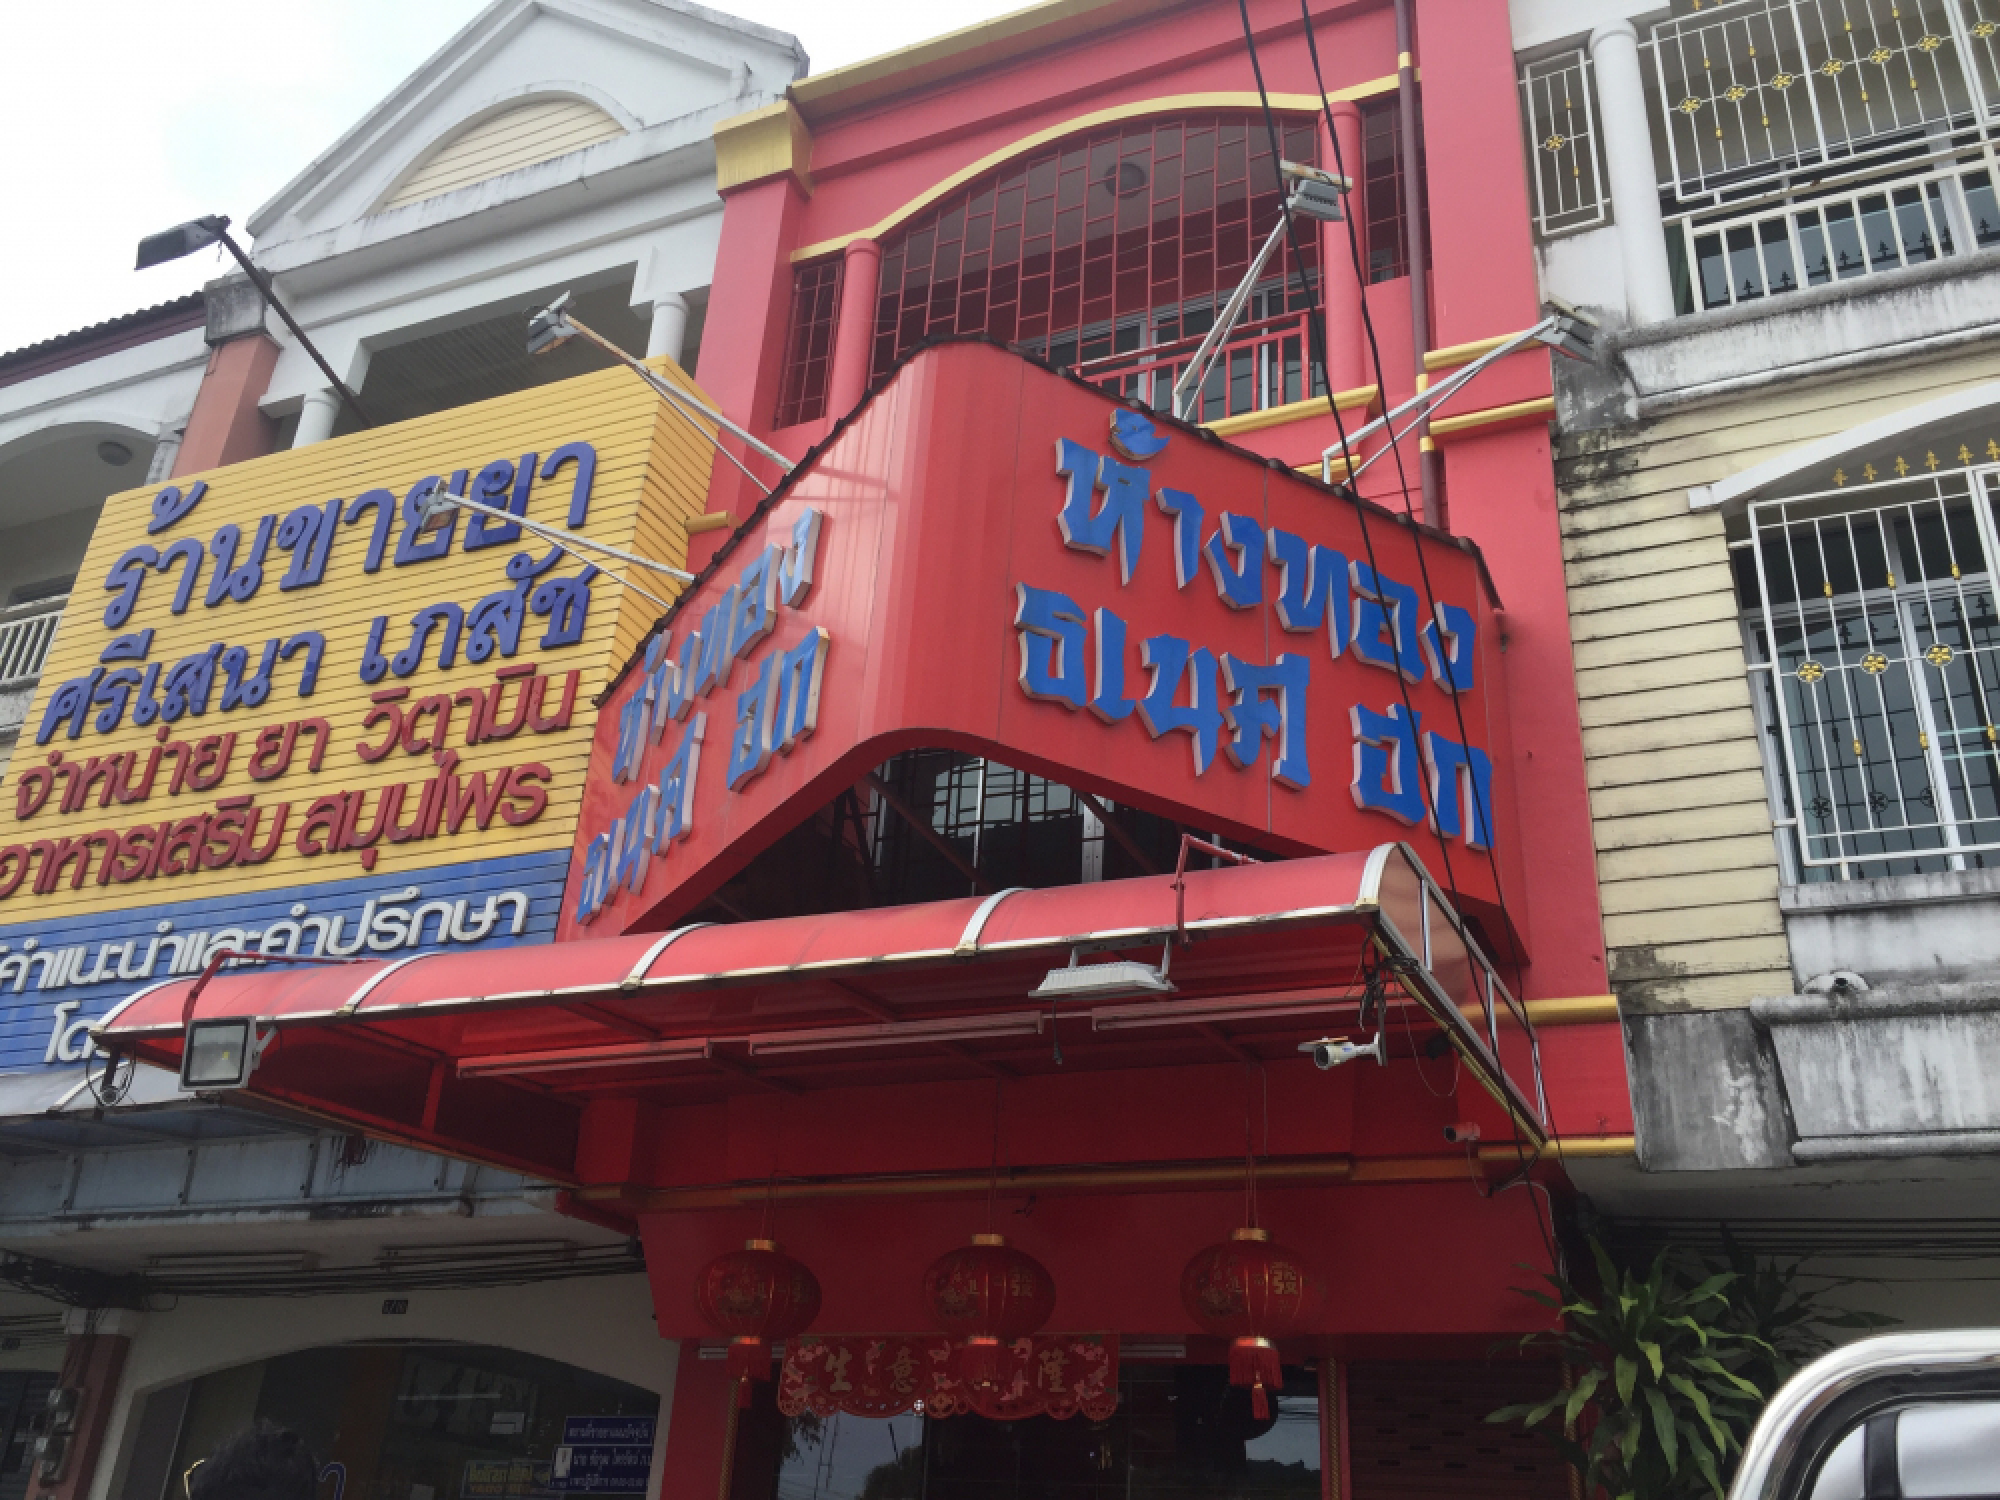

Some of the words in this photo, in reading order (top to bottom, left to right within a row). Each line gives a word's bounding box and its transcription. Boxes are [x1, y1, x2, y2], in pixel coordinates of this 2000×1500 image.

[104, 441, 597, 629] ร้านขายยา
[1056, 407, 1476, 695] ห้างทอง
[36, 628, 326, 745] ศรีเสนา
[359, 543, 601, 686] เภสัช
[612, 507, 823, 785] ห้างทอง
[1014, 581, 1312, 792] ธเนศ
[1349, 703, 1494, 853] ฮก
[0, 795, 290, 898] อาหารเสริม
[295, 748, 552, 869] สมุนไพร
[16, 725, 237, 820] จำหน่าย
[247, 717, 332, 782] ยา
[355, 662, 580, 764] วิตามิน
[0, 886, 528, 993] คำแนะนำและคำปรึกษา
[44, 1000, 111, 1062] โด
[824, 1345, 1070, 1394] 生意隆
